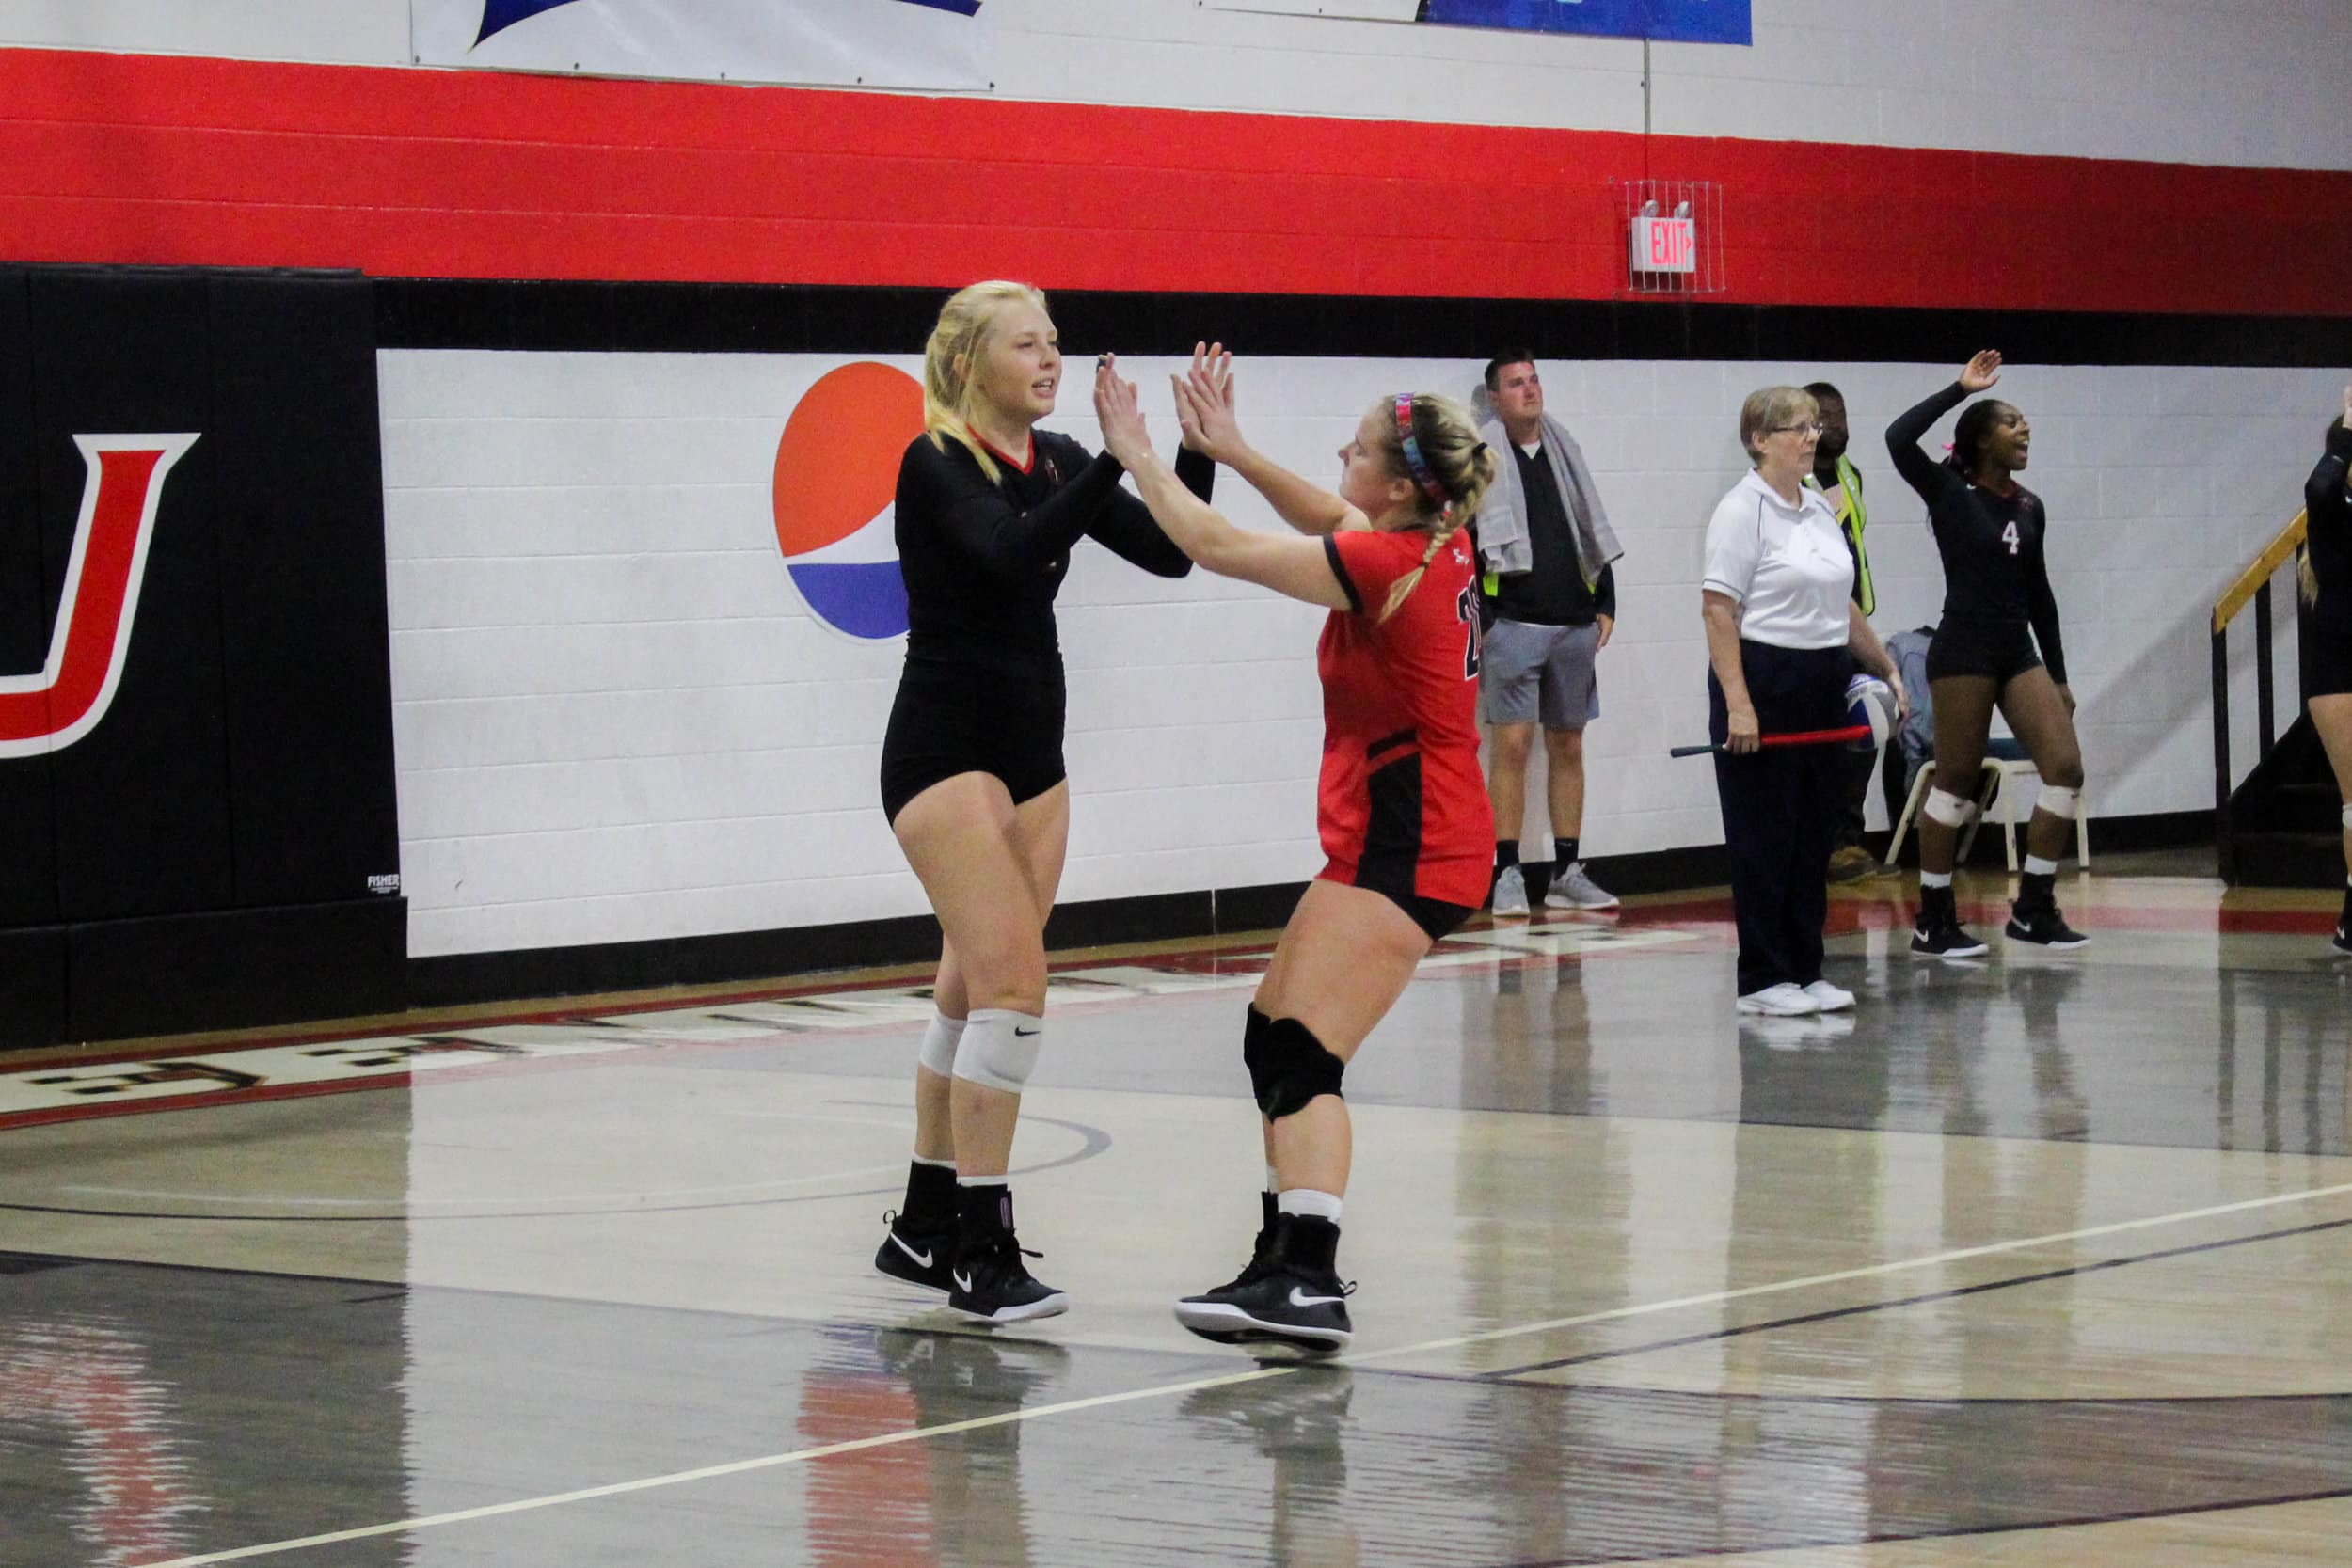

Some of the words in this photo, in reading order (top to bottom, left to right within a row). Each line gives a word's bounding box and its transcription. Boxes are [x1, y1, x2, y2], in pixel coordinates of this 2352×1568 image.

[1650, 220, 1687, 266] EXIT
[2001, 519, 2020, 555] 4
[368, 874, 400, 889] FISHER
